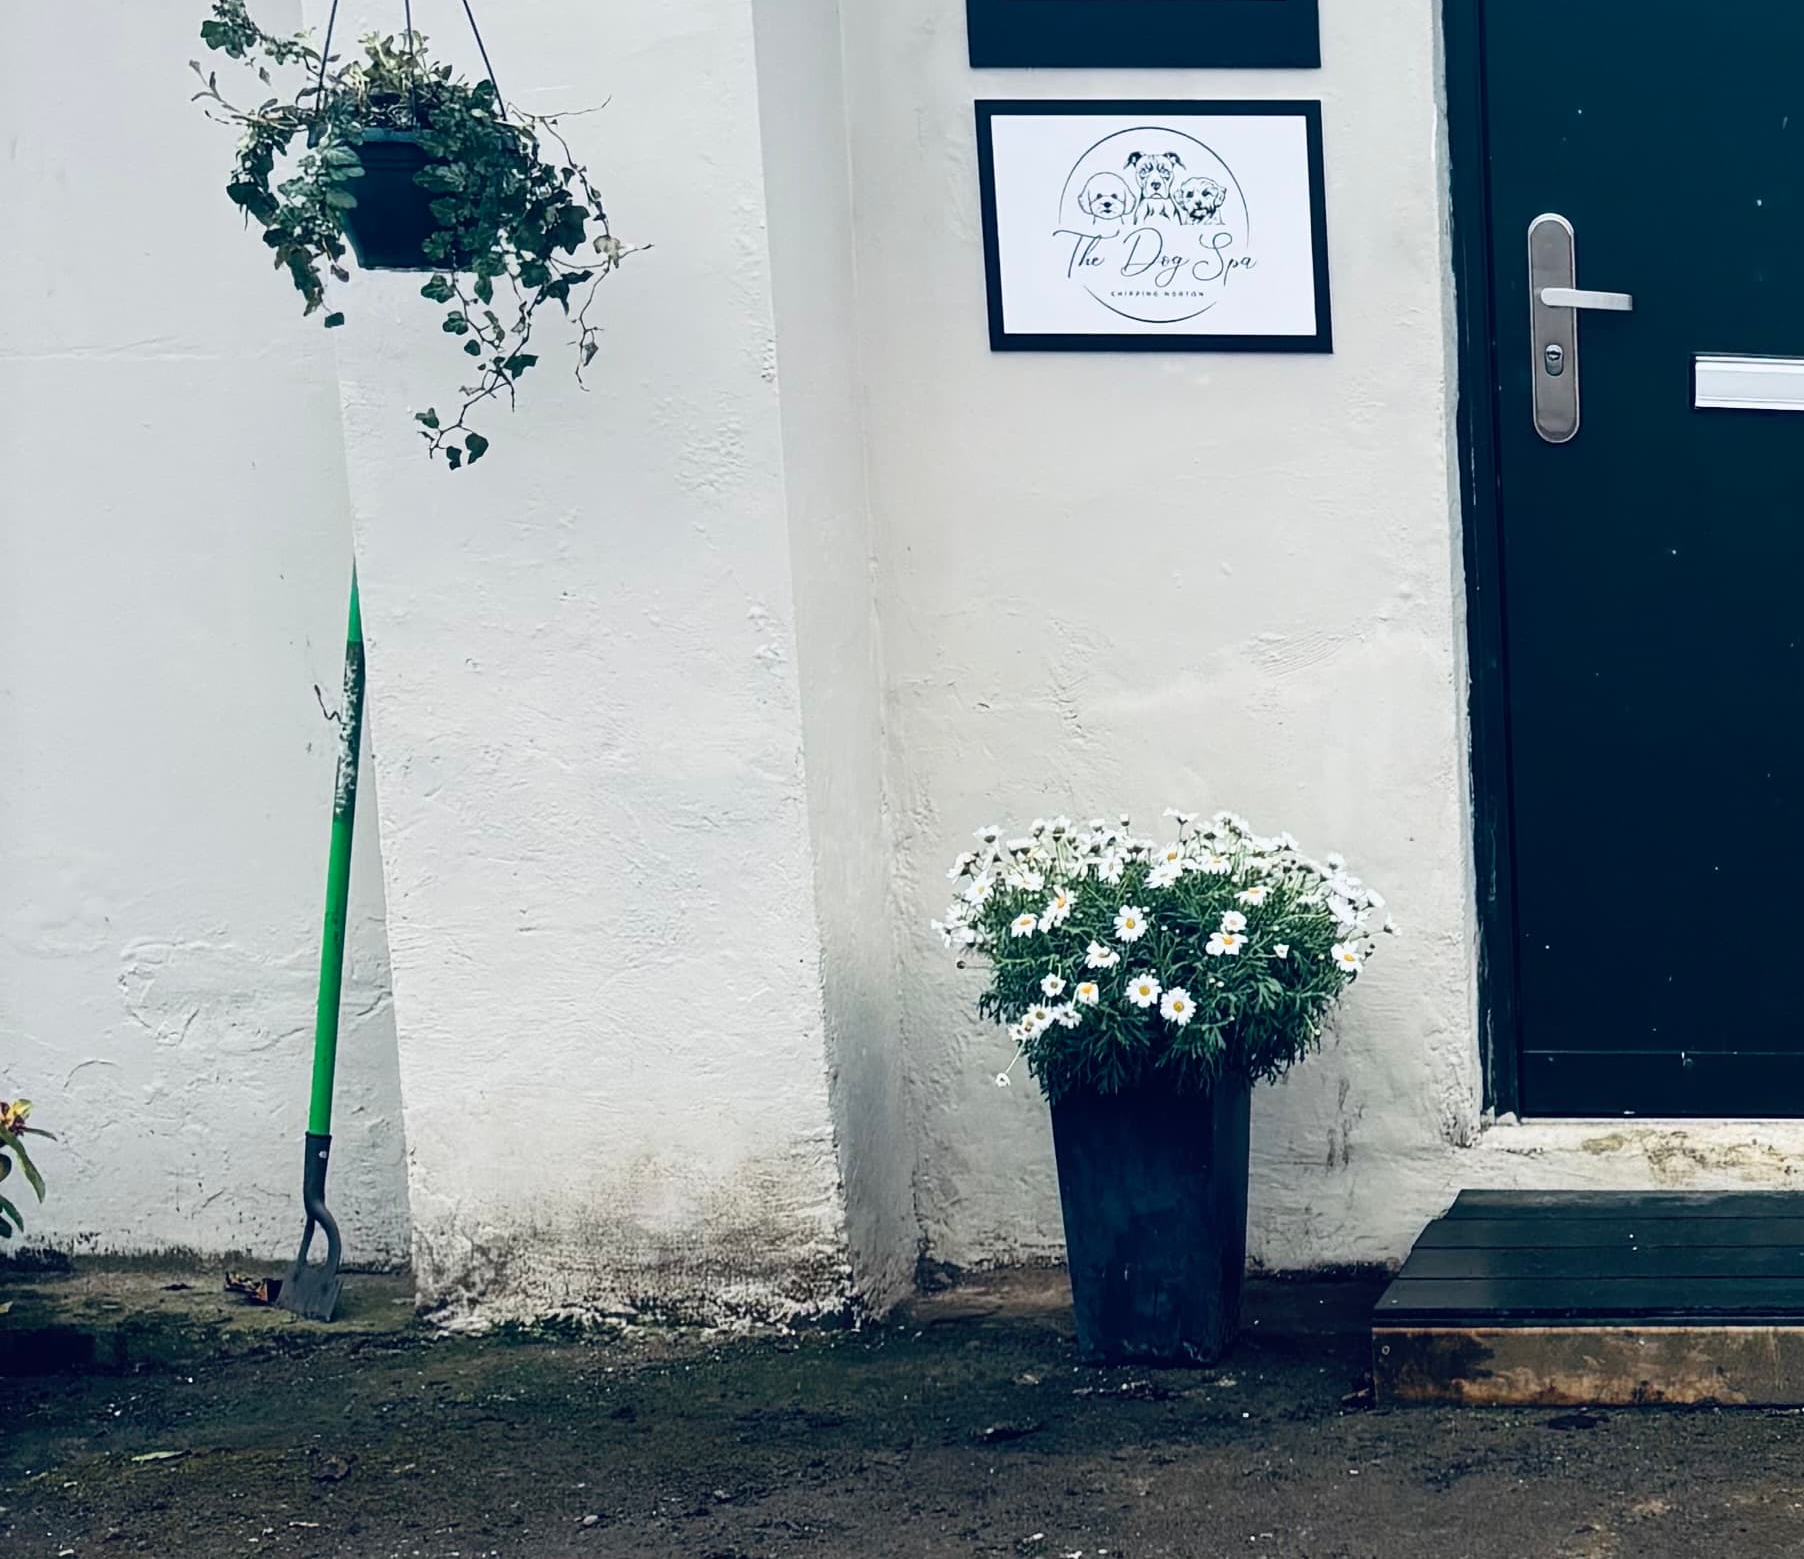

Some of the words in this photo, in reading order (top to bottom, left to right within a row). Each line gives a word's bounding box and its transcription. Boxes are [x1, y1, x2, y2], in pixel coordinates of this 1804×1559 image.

[1052, 229, 1121, 279] The
[1120, 227, 1191, 288] Dog
[1192, 232, 1257, 287] Spa
